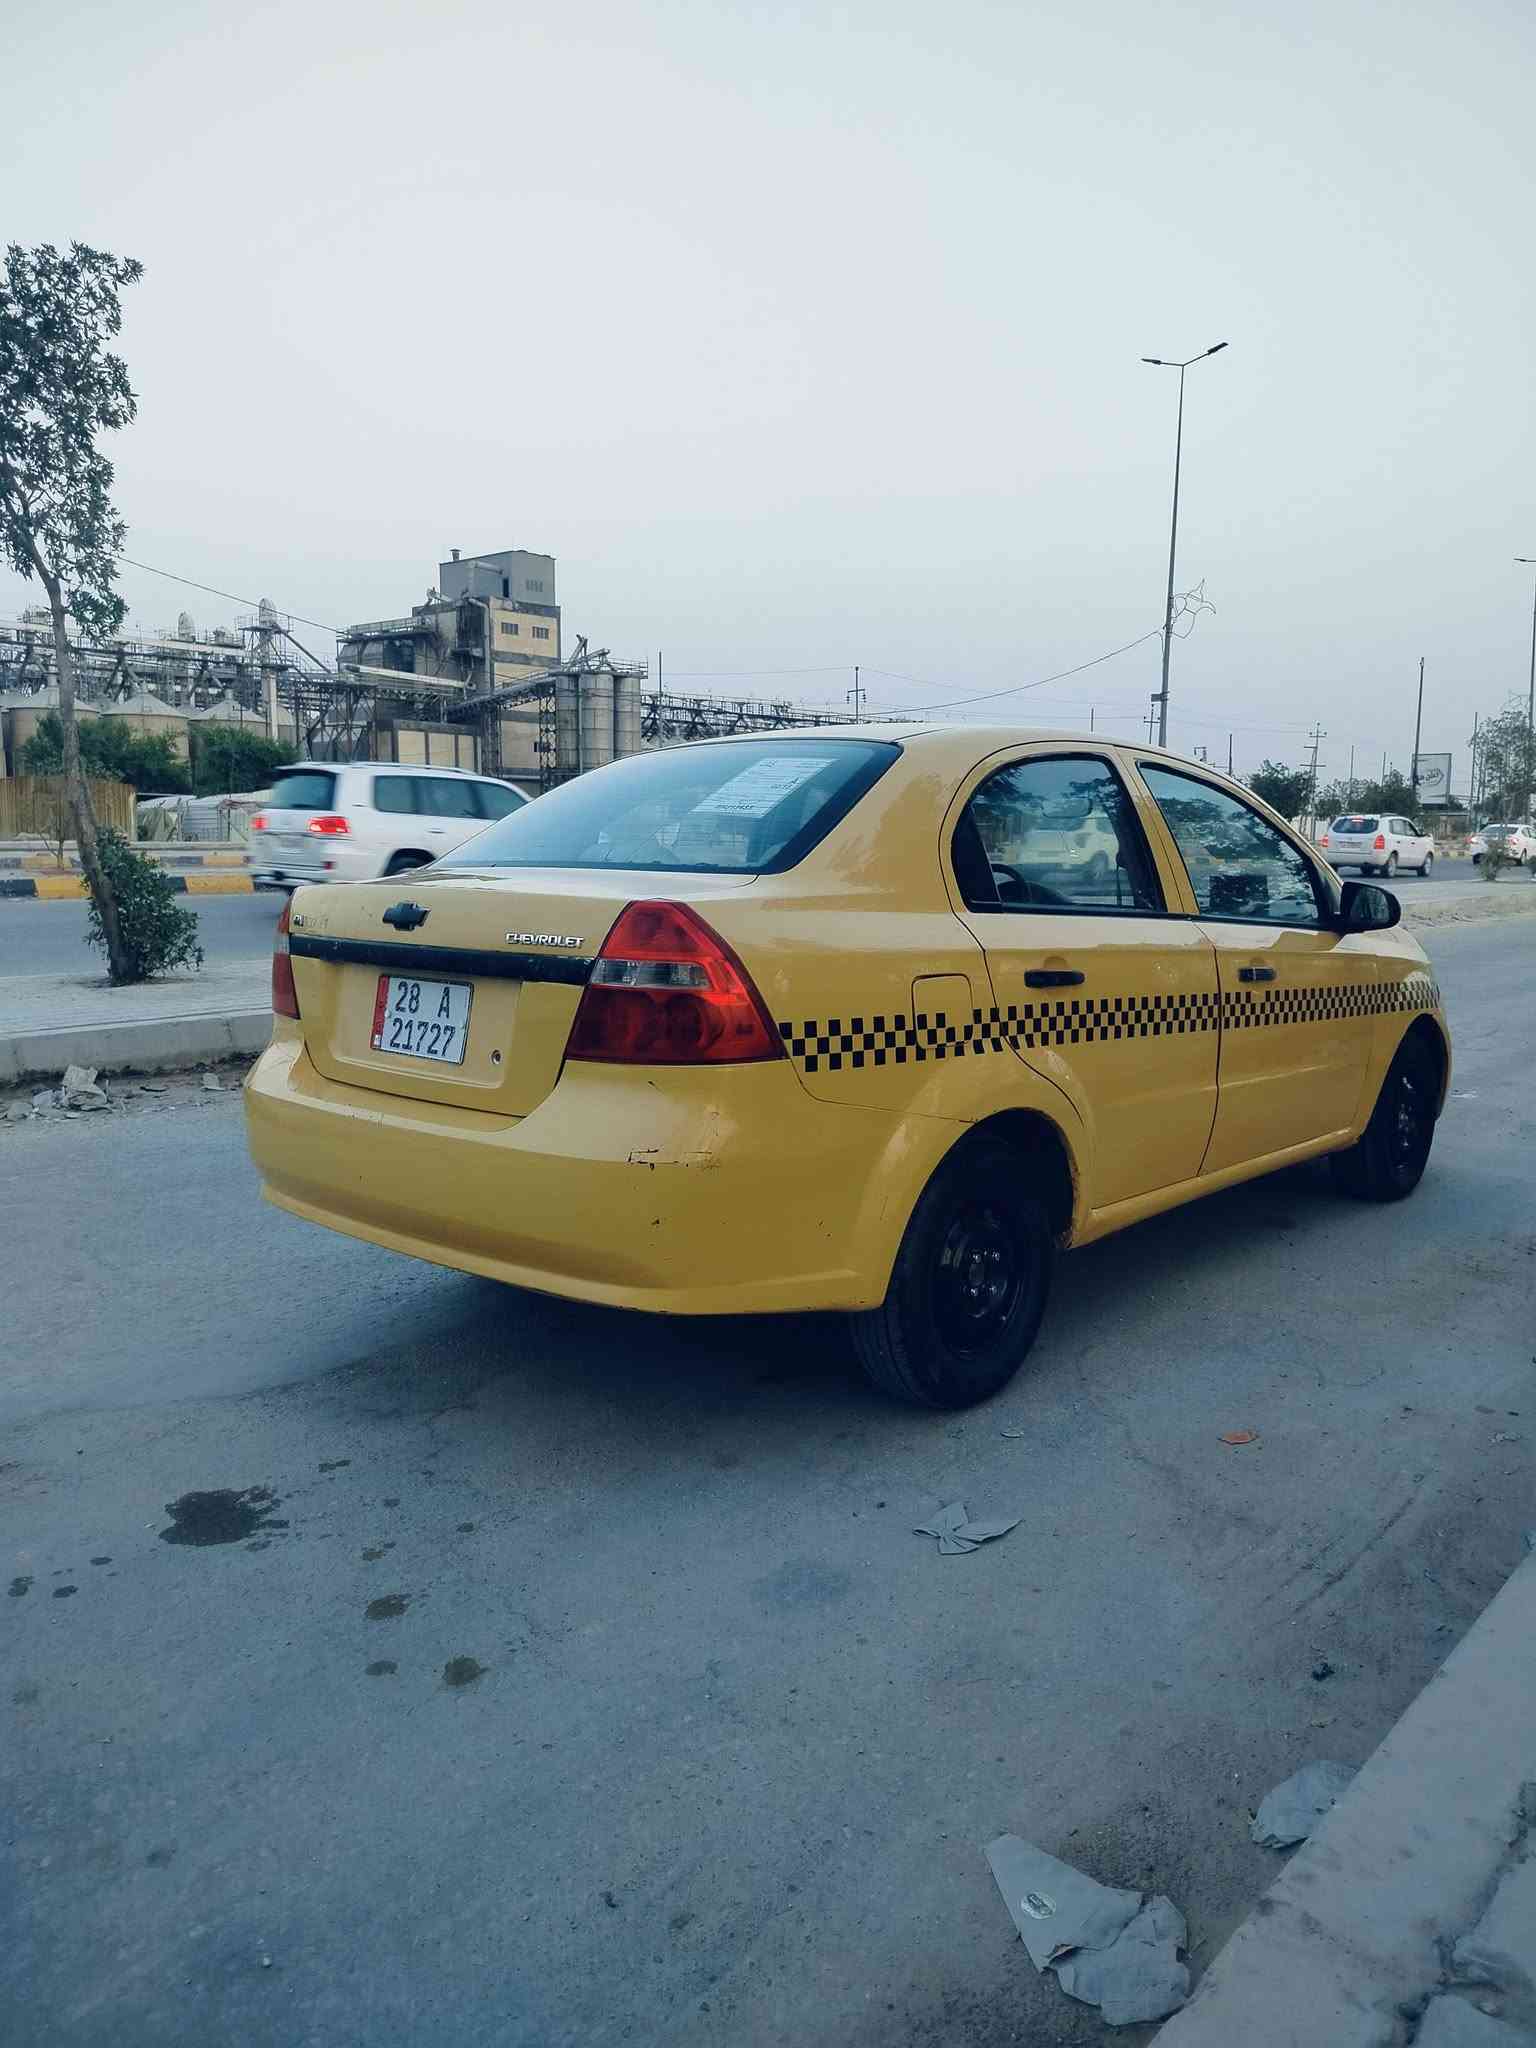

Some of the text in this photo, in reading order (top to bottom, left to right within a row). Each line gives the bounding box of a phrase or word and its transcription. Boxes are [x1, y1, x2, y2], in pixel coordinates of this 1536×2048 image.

[505, 933, 584, 949] CHEVROLET
[395, 981, 420, 1014] 28
[437, 986, 450, 1019] A
[389, 1017, 456, 1057] 21727
